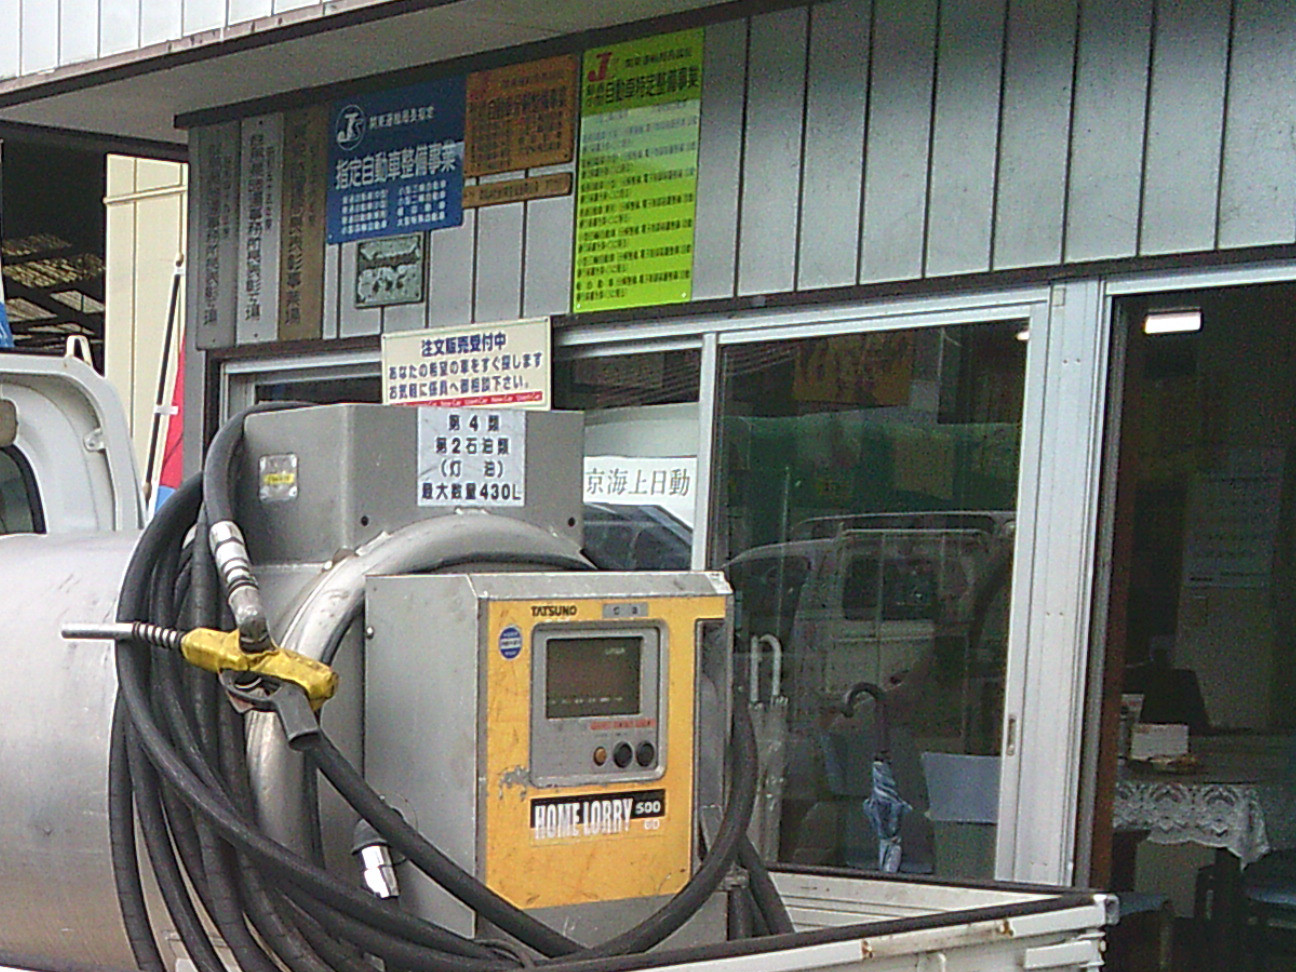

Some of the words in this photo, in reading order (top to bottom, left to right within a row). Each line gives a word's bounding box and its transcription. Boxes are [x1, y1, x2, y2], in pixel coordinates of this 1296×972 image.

[335, 140, 456, 191] 指定自動車整備事業
[421, 331, 506, 357] 注文販売受付中
[389, 352, 543, 380] あなたの希望の車をすぐ探します
[435, 437, 509, 455] 第2石油類
[421, 482, 522, 501] 最大数量430L
[585, 467, 691, 497] 京海上日動
[530, 605, 577, 617] TATSUNO
[534, 803, 580, 840] HOME
[583, 798, 634, 837] LORRY
[635, 800, 661, 815] 500
